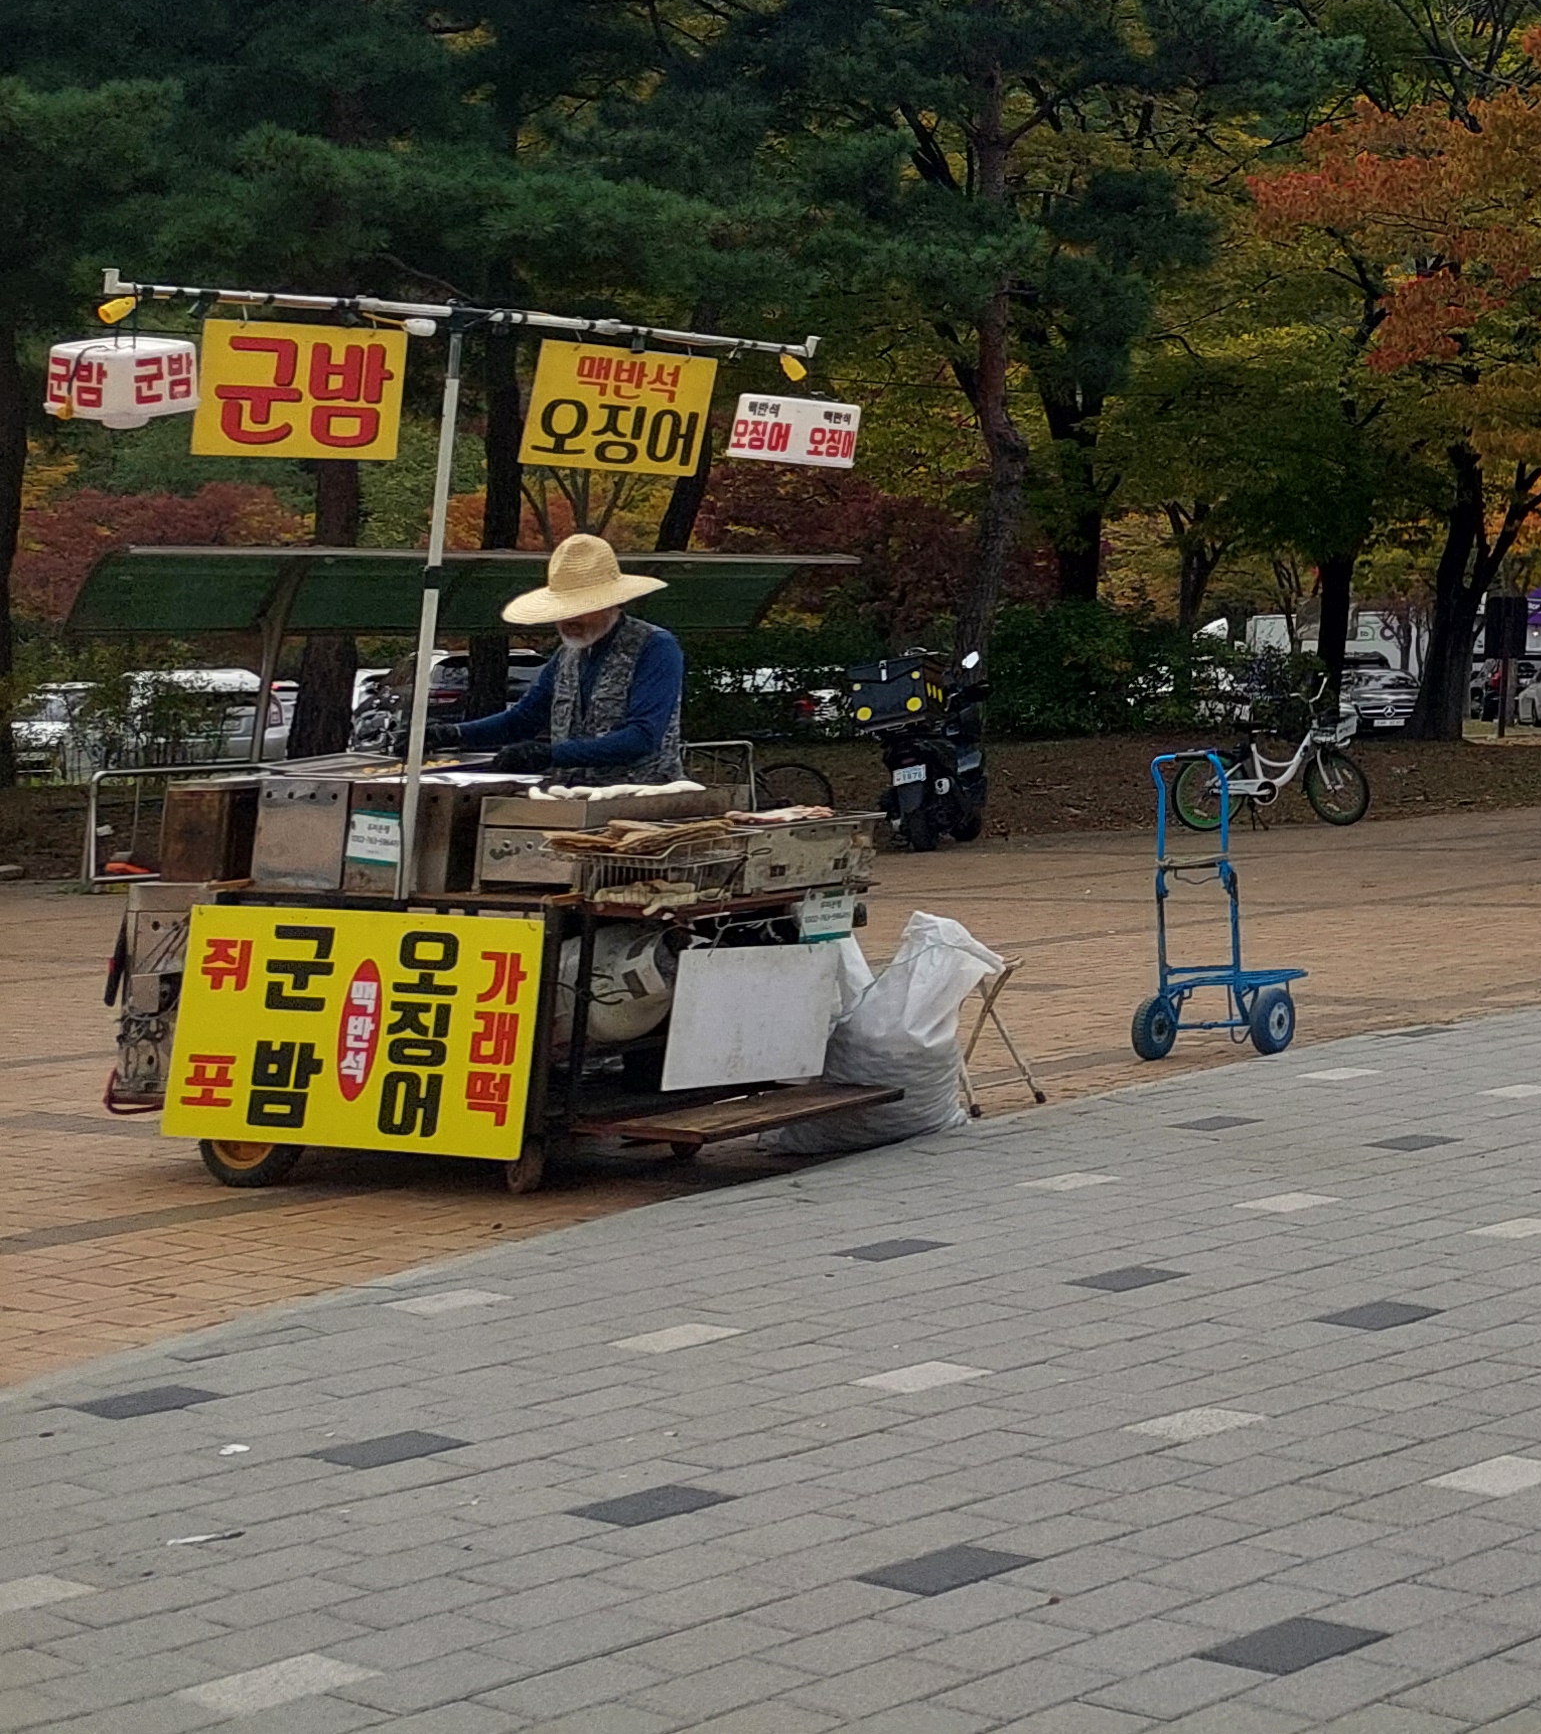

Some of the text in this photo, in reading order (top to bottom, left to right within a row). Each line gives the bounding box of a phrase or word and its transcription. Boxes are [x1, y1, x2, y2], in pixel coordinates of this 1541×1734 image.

[50, 357, 108, 408] 군밤
[134, 352, 193, 405] 군밤
[213, 335, 395, 448] 군밤
[576, 354, 682, 404] 맥반석
[531, 398, 700, 467] 오징어
[730, 419, 793, 453] 오징어
[806, 427, 855, 459] 오징어
[246, 924, 337, 1130] 군밤
[338, 980, 379, 1084] 맥반석
[376, 930, 460, 1138] 오징어
[464, 950, 528, 1127] 가래떡
